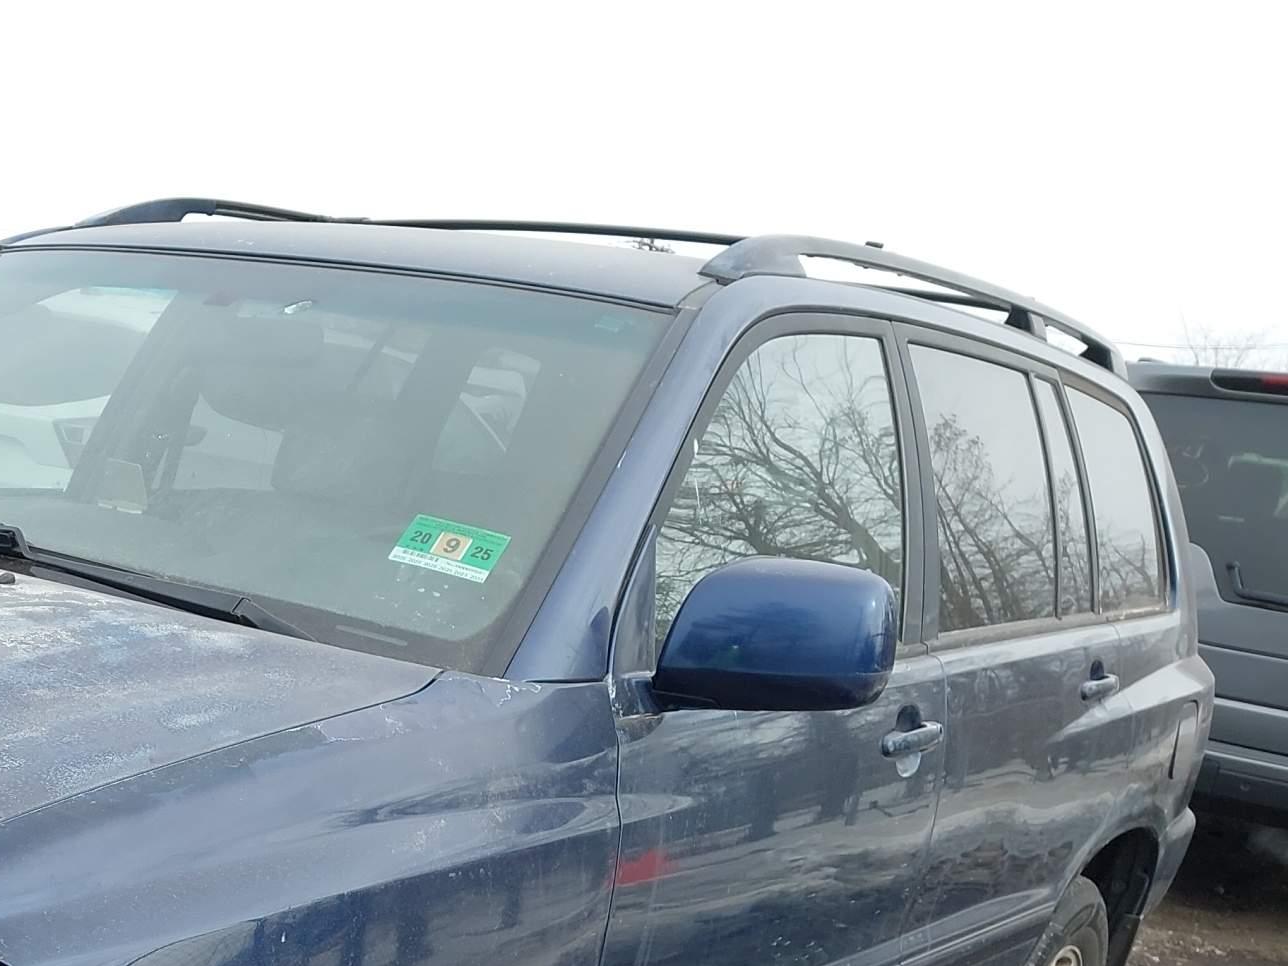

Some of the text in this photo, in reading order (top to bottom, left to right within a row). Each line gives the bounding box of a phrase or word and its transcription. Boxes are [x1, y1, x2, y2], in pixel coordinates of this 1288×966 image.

[410, 531, 493, 561] 20 9 25
